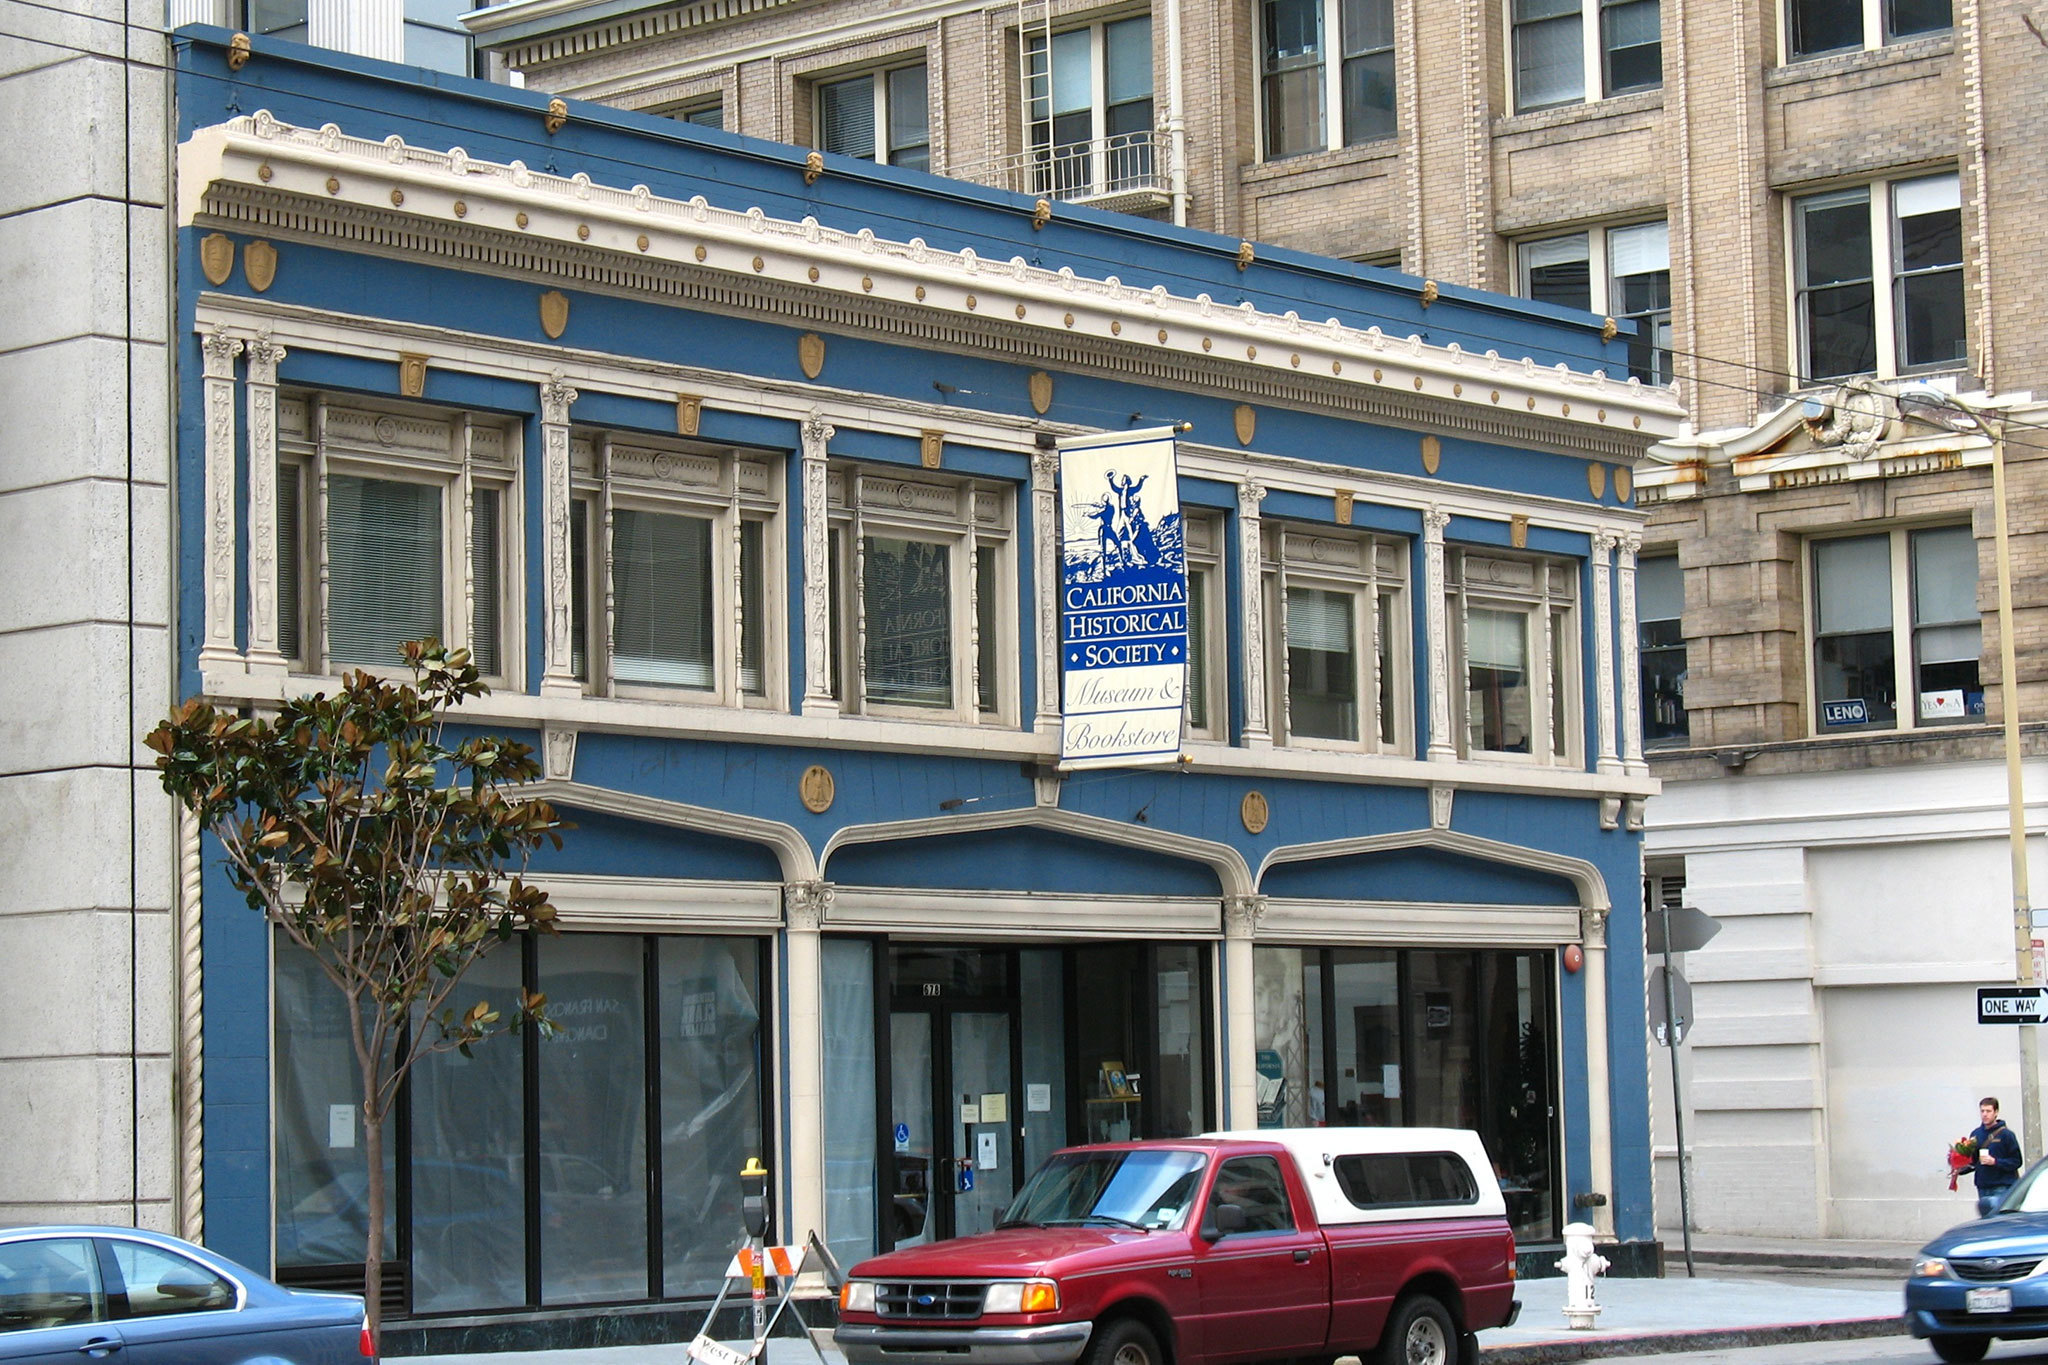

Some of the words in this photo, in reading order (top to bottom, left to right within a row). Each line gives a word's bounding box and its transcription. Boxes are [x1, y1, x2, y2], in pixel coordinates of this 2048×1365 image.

[1066, 582, 1183, 609] CALIFORNIA
[1069, 611, 1184, 638] HISTORICAL
[1085, 643, 1167, 668] SOCIETY
[1066, 677, 1155, 707] Museum
[1159, 677, 1180, 700] &
[1826, 705, 1864, 720] LENO
[1065, 721, 1175, 751] Bookstore
[923, 983, 941, 996] 678
[1984, 999, 2009, 1013] ONE
[2015, 999, 2038, 1013] WAY
[1585, 1285, 1595, 1299] 12
